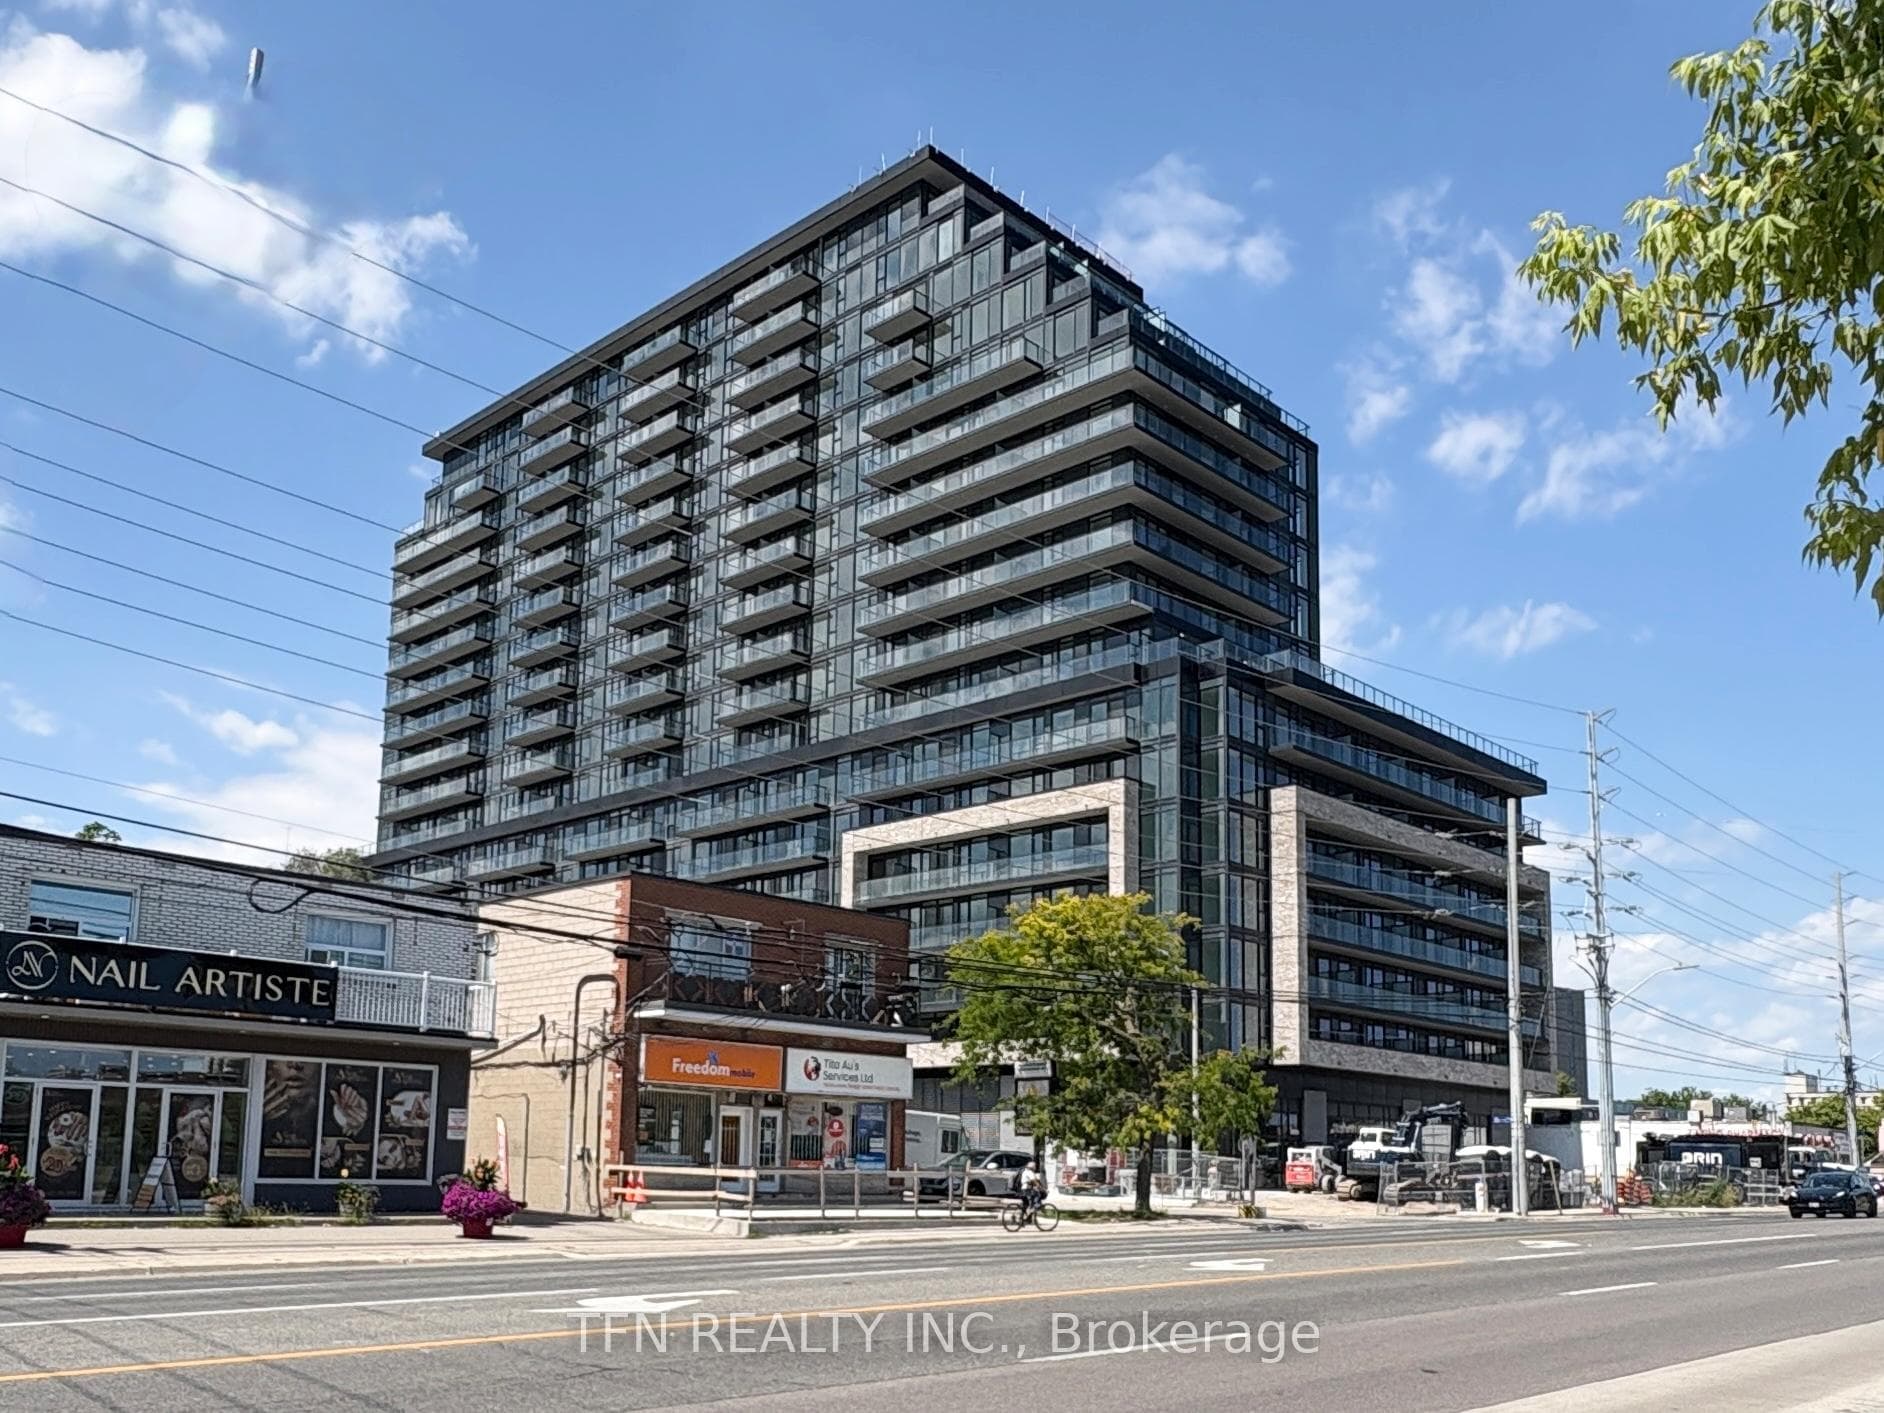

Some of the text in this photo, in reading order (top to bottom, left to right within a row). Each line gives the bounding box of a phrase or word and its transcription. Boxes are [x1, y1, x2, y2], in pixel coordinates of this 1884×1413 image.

[69, 954, 331, 1007] NAIL ARTISTE
[672, 1057, 731, 1076] Freedom
[823, 1071, 874, 1084] Services Ltd
